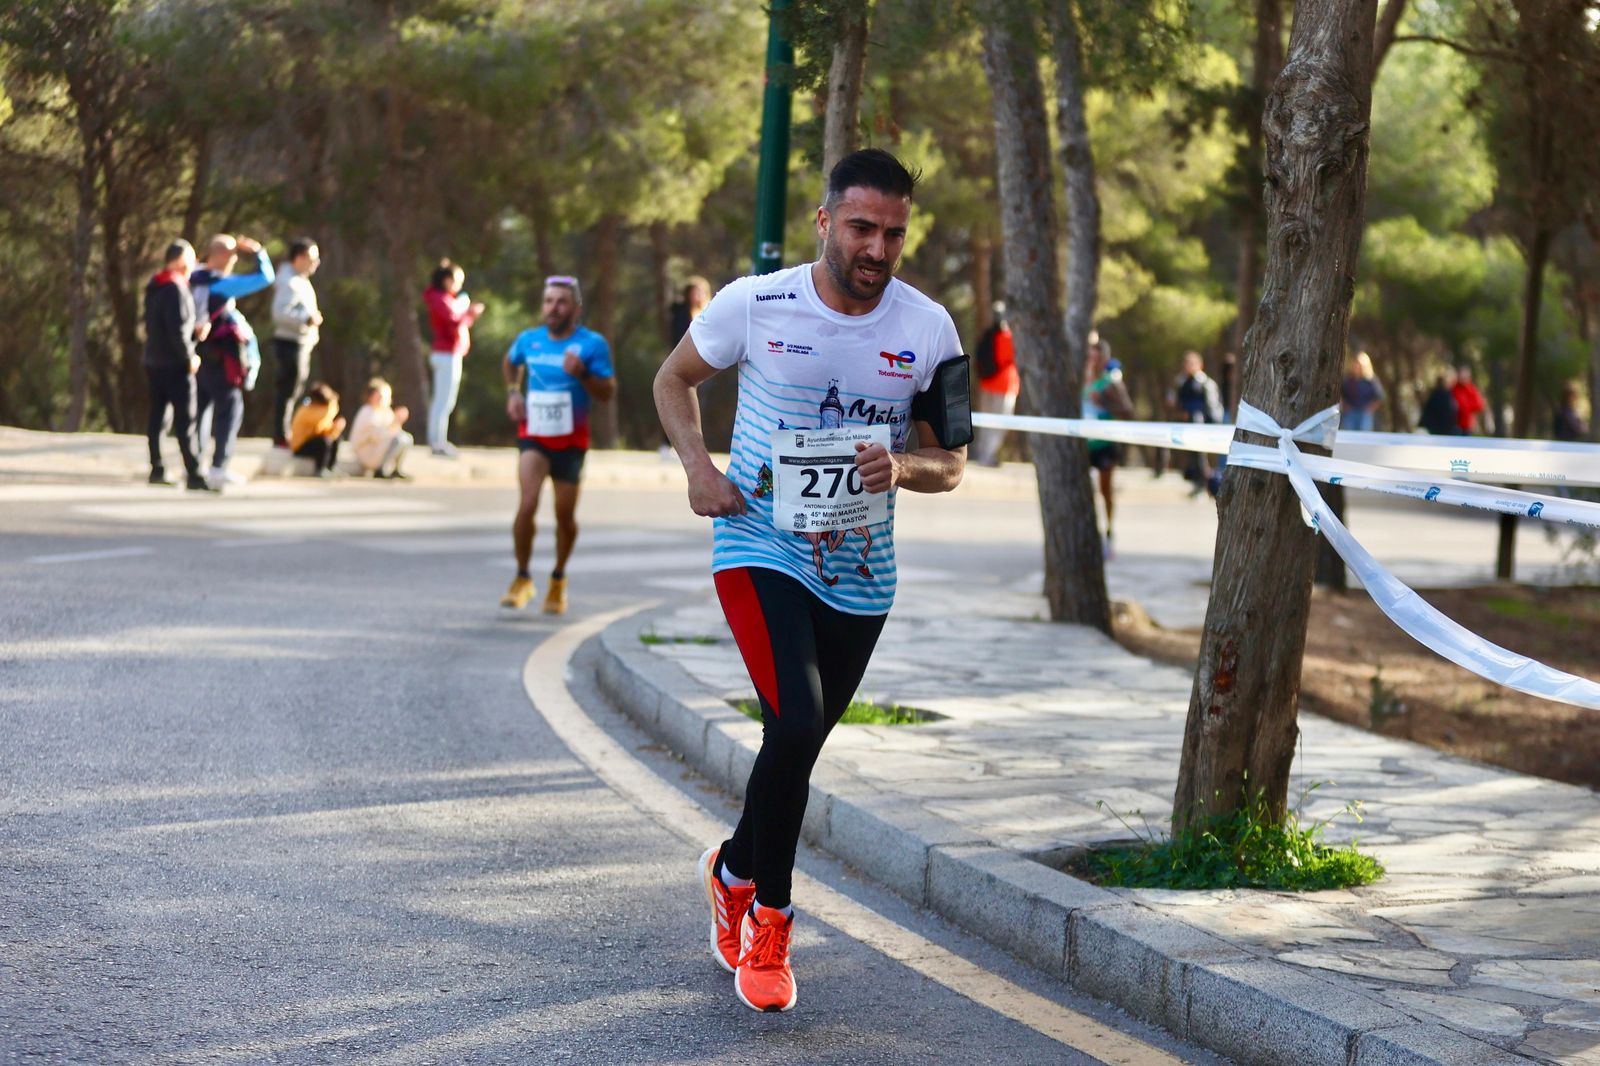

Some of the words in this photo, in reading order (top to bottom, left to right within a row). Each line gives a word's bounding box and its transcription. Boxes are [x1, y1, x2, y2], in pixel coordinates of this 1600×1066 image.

[755, 292, 786, 302] luanvi
[878, 370, 913, 379] TotalEnergies
[800, 467, 864, 499] 270
[843, 500, 864, 508] DELGADO
[838, 505, 870, 517] MARATÓN
[811, 519, 830, 527] PEÑA
[841, 514, 867, 524] BASTÓN
